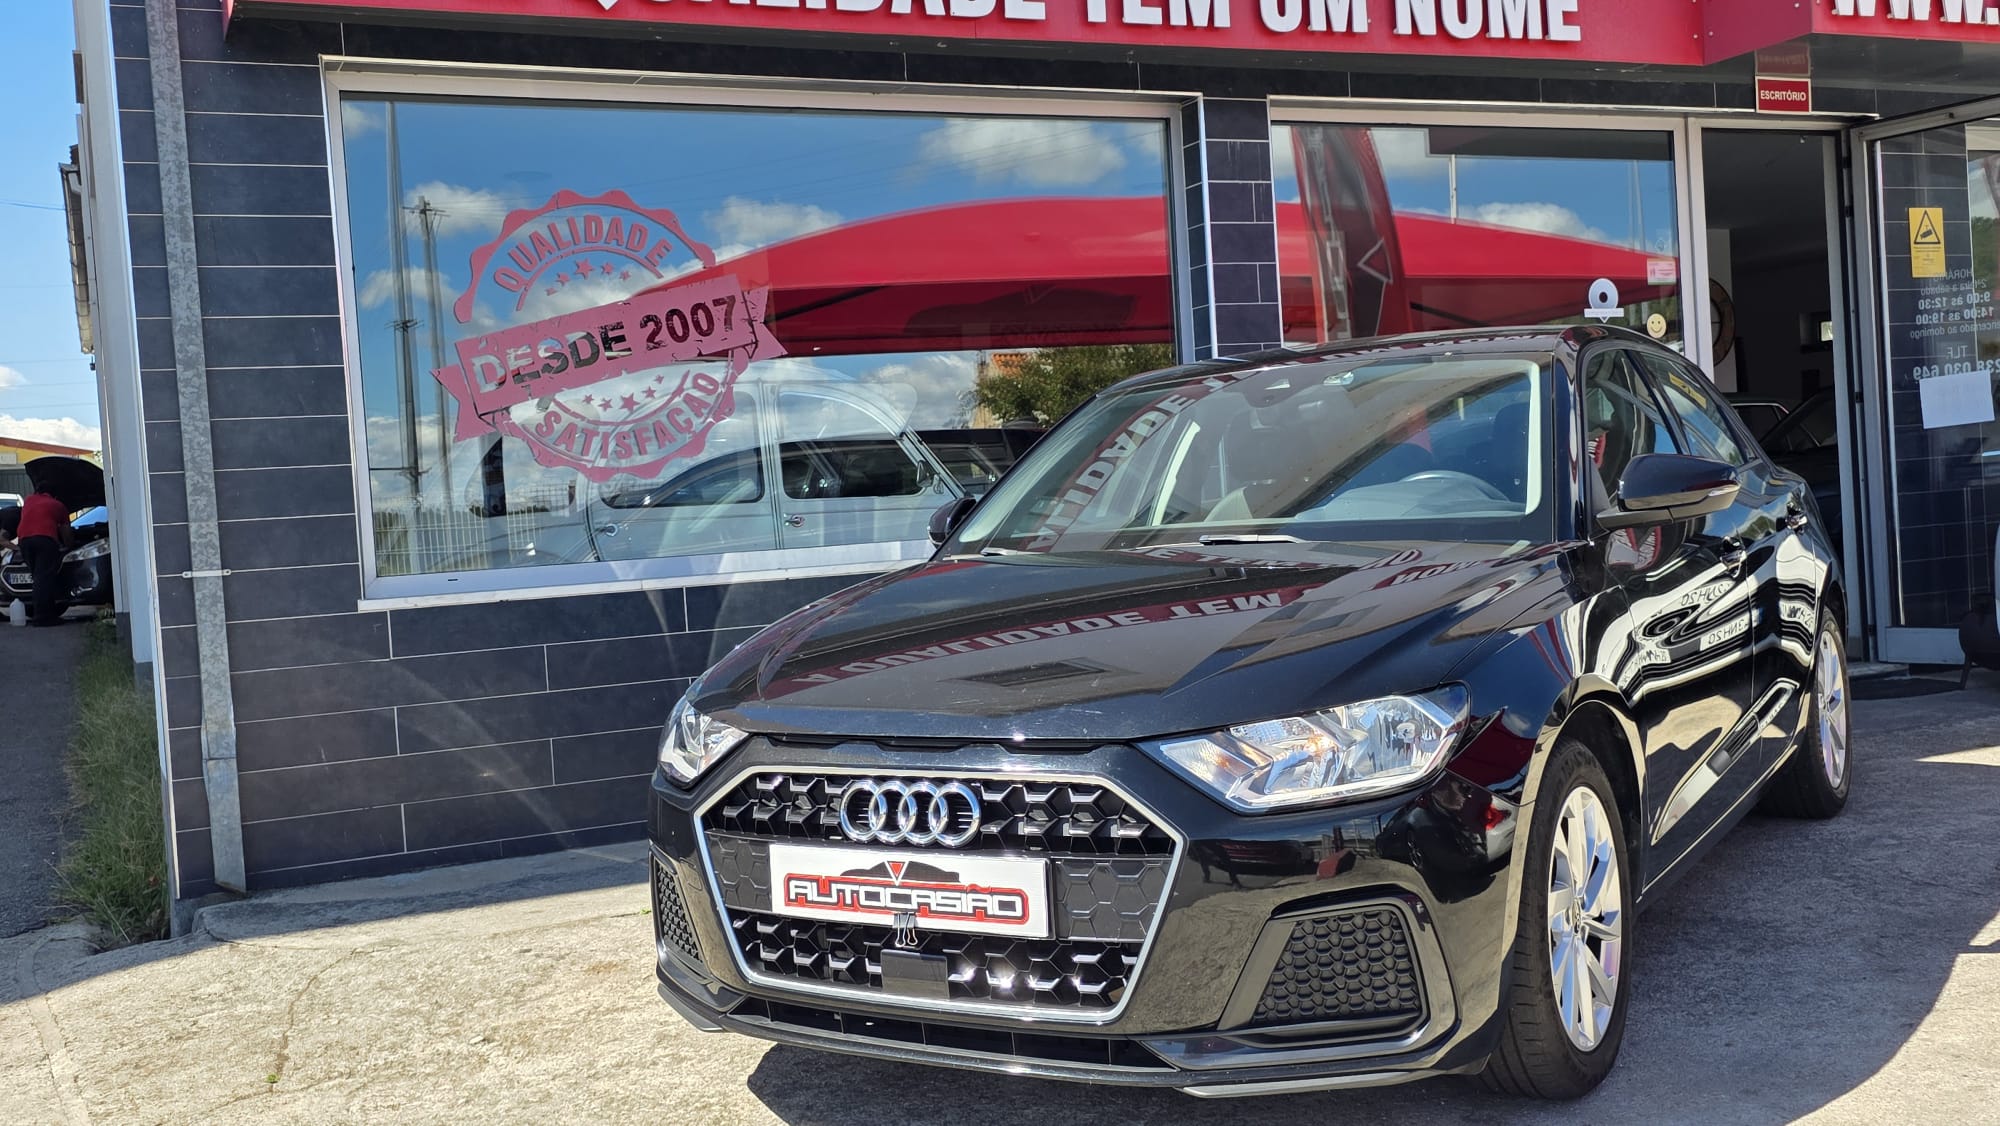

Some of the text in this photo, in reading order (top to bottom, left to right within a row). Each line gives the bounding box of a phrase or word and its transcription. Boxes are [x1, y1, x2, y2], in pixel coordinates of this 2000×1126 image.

[1760, 89, 1806, 102] ESCRITÓRIO
[493, 214, 673, 293] QUALIDADE
[471, 295, 738, 394] DESDE 2007
[789, 879, 1023, 917] AUTOCASIÃO
